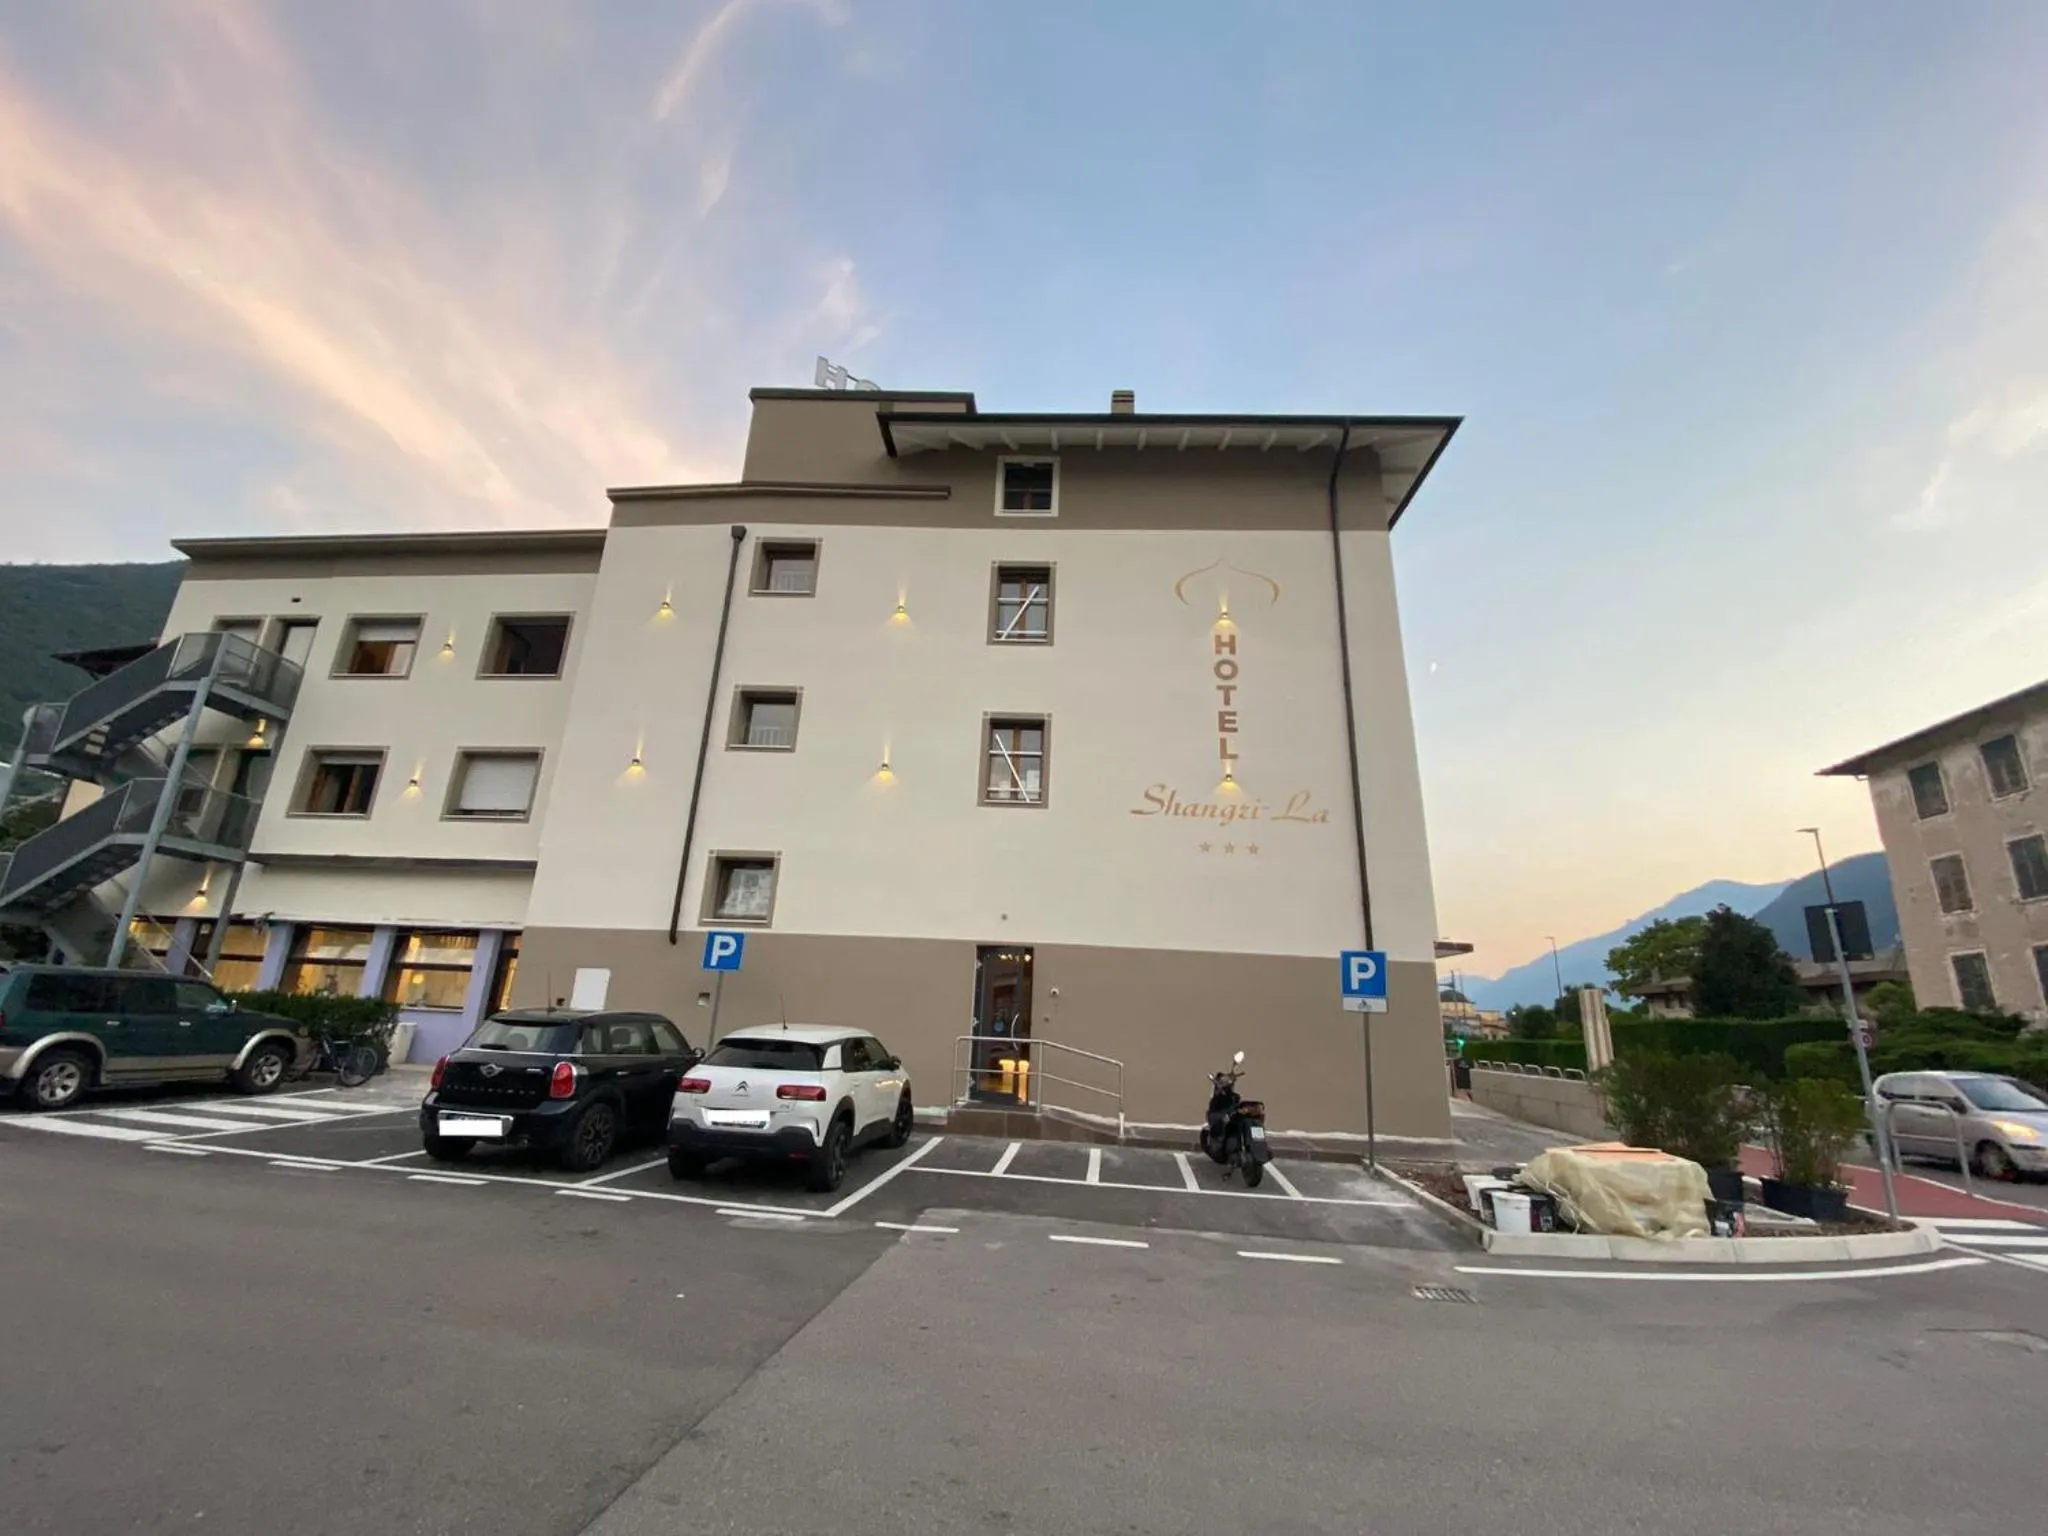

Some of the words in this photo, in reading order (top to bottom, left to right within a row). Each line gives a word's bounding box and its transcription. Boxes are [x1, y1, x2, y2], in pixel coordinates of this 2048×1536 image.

[1213, 634, 1239, 760] HOTEL
[709, 935, 737, 967] P
[1350, 956, 1377, 991] P
